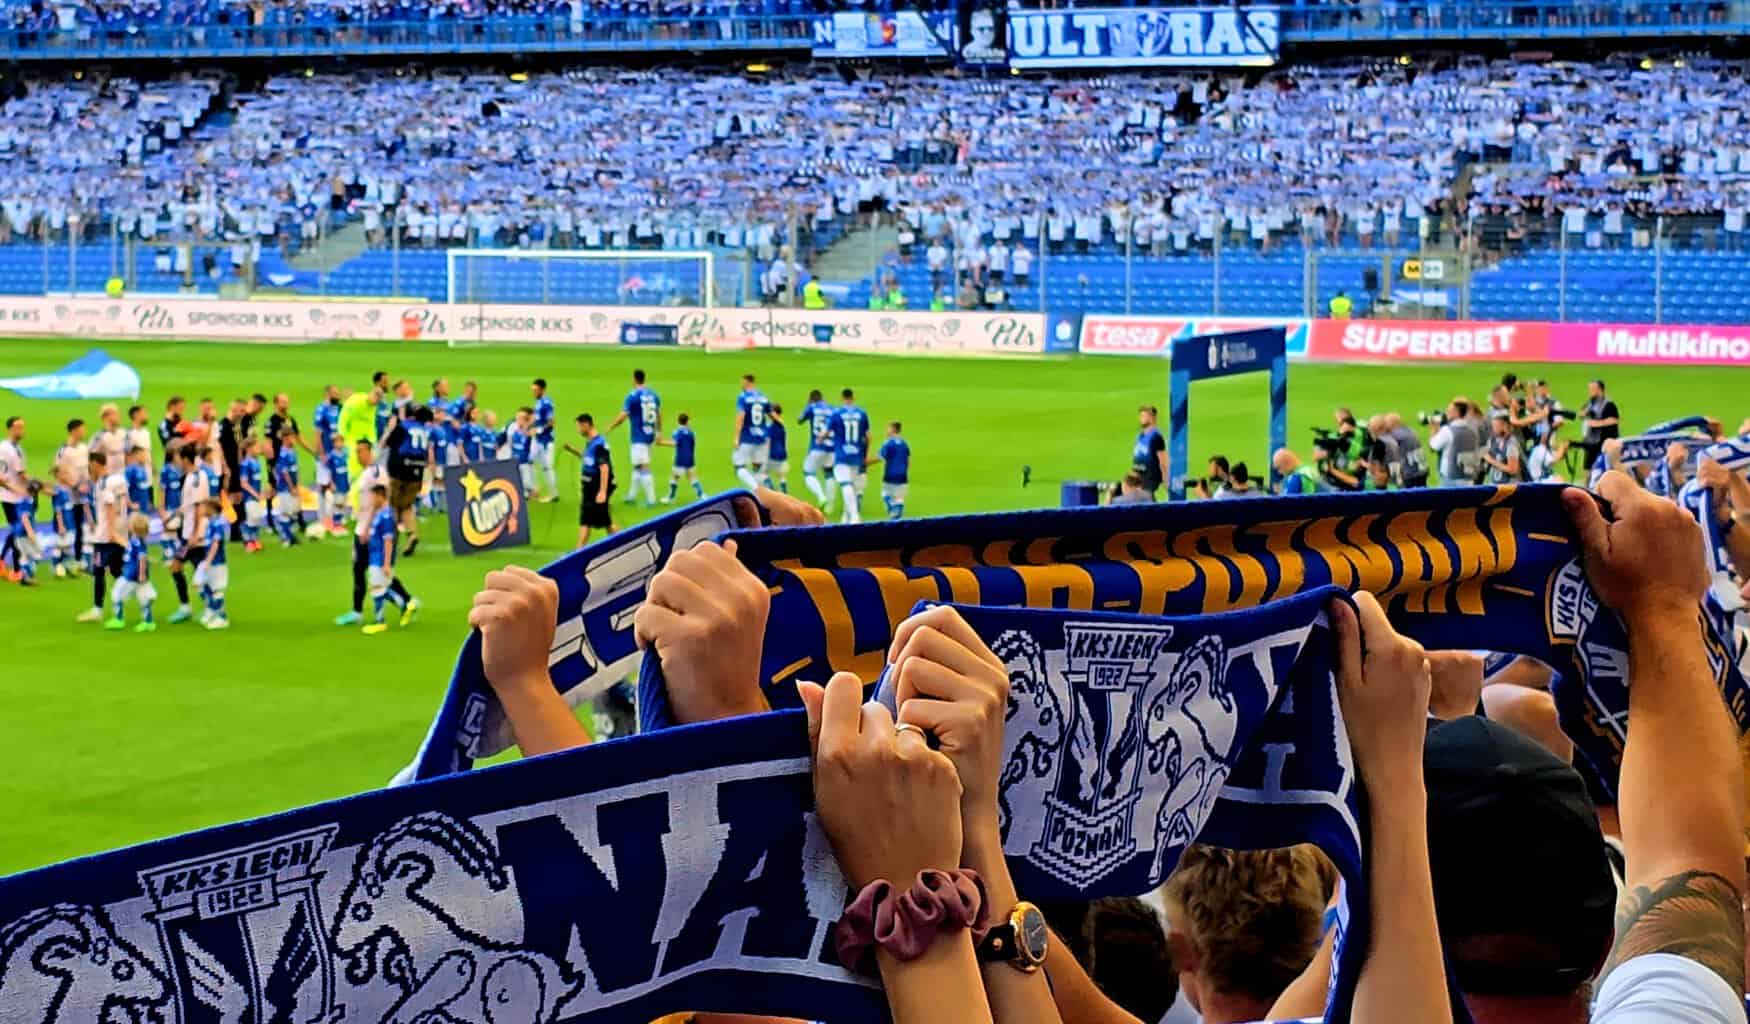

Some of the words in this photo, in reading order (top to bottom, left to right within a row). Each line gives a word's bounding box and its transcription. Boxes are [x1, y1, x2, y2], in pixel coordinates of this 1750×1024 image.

[188, 311, 258, 327] SPONSOR
[264, 312, 294, 328] KKS
[460, 315, 536, 332] SPONSOR
[541, 317, 574, 333] KKS
[741, 320, 809, 338] SPONSO
[1093, 324, 1159, 348] tesa
[1341, 322, 1516, 356] SUPERBET
[1596, 328, 1750, 360] Multikino
[751, 402, 763, 425] 6
[844, 419, 859, 443] 11
[1094, 666, 1124, 686] 1922
[207, 882, 264, 913] 1922
